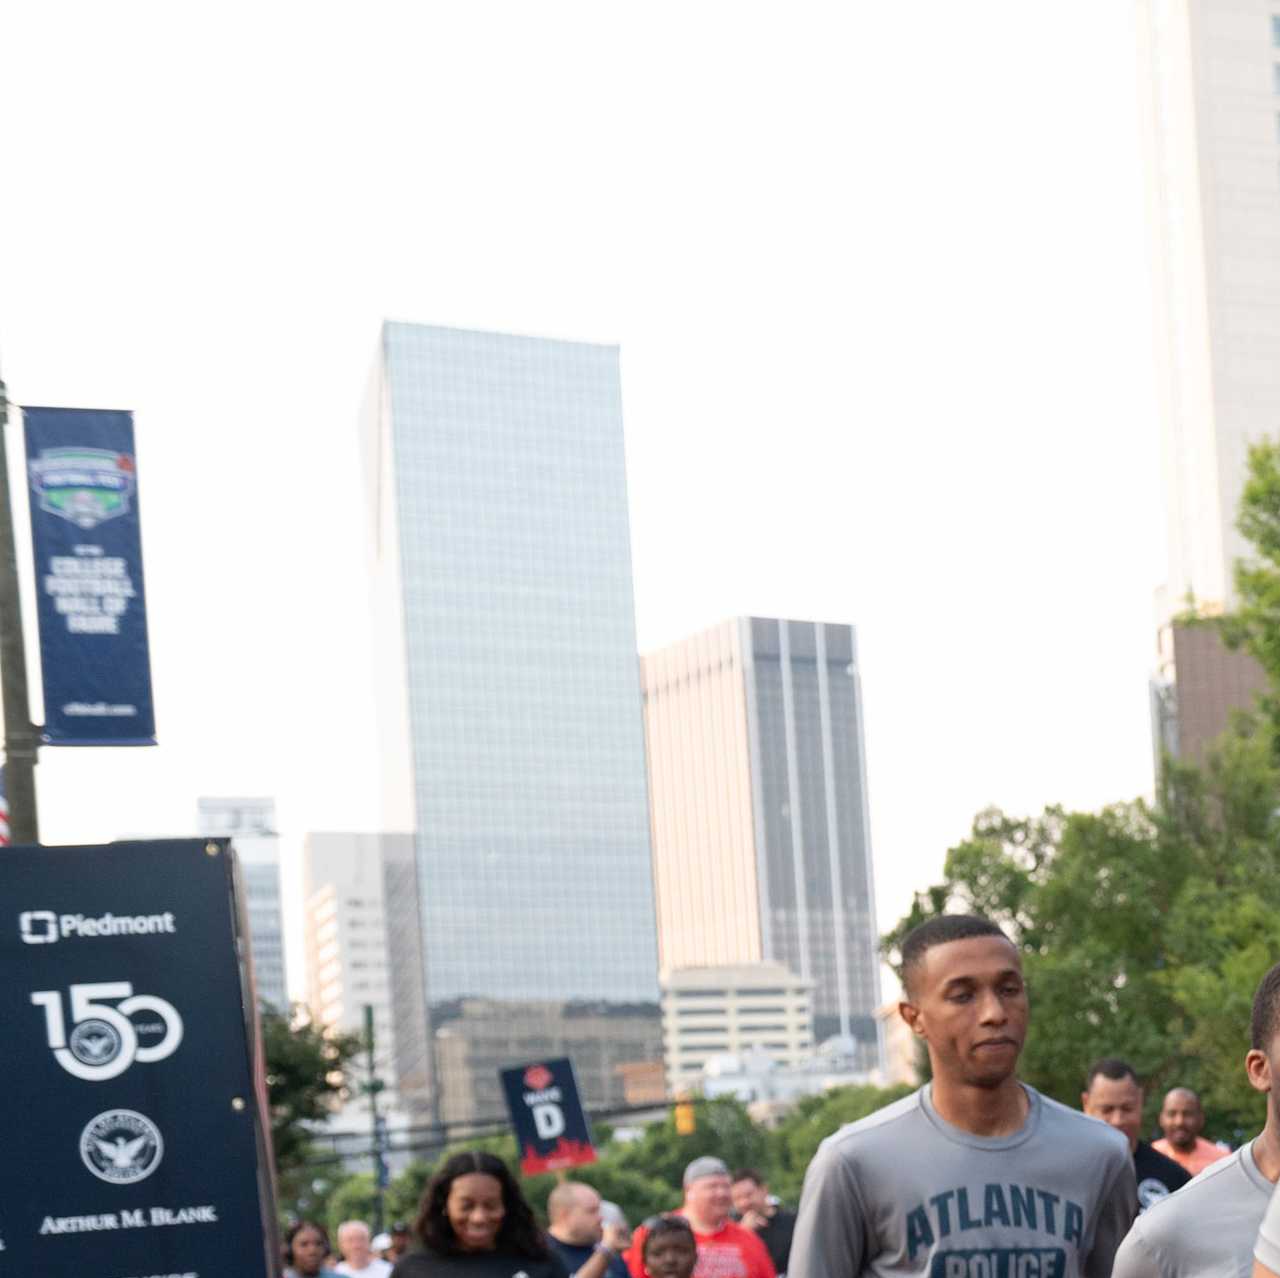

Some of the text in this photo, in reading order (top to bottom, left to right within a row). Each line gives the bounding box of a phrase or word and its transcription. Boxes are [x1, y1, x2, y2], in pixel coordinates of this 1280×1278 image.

[60, 911, 176, 938] Piedmont
[30, 980, 184, 1081] 150
[532, 1103, 567, 1140] D
[39, 1205, 218, 1236] ARTHUR M. BLANK
[906, 1183, 1084, 1261] ATLANTA
